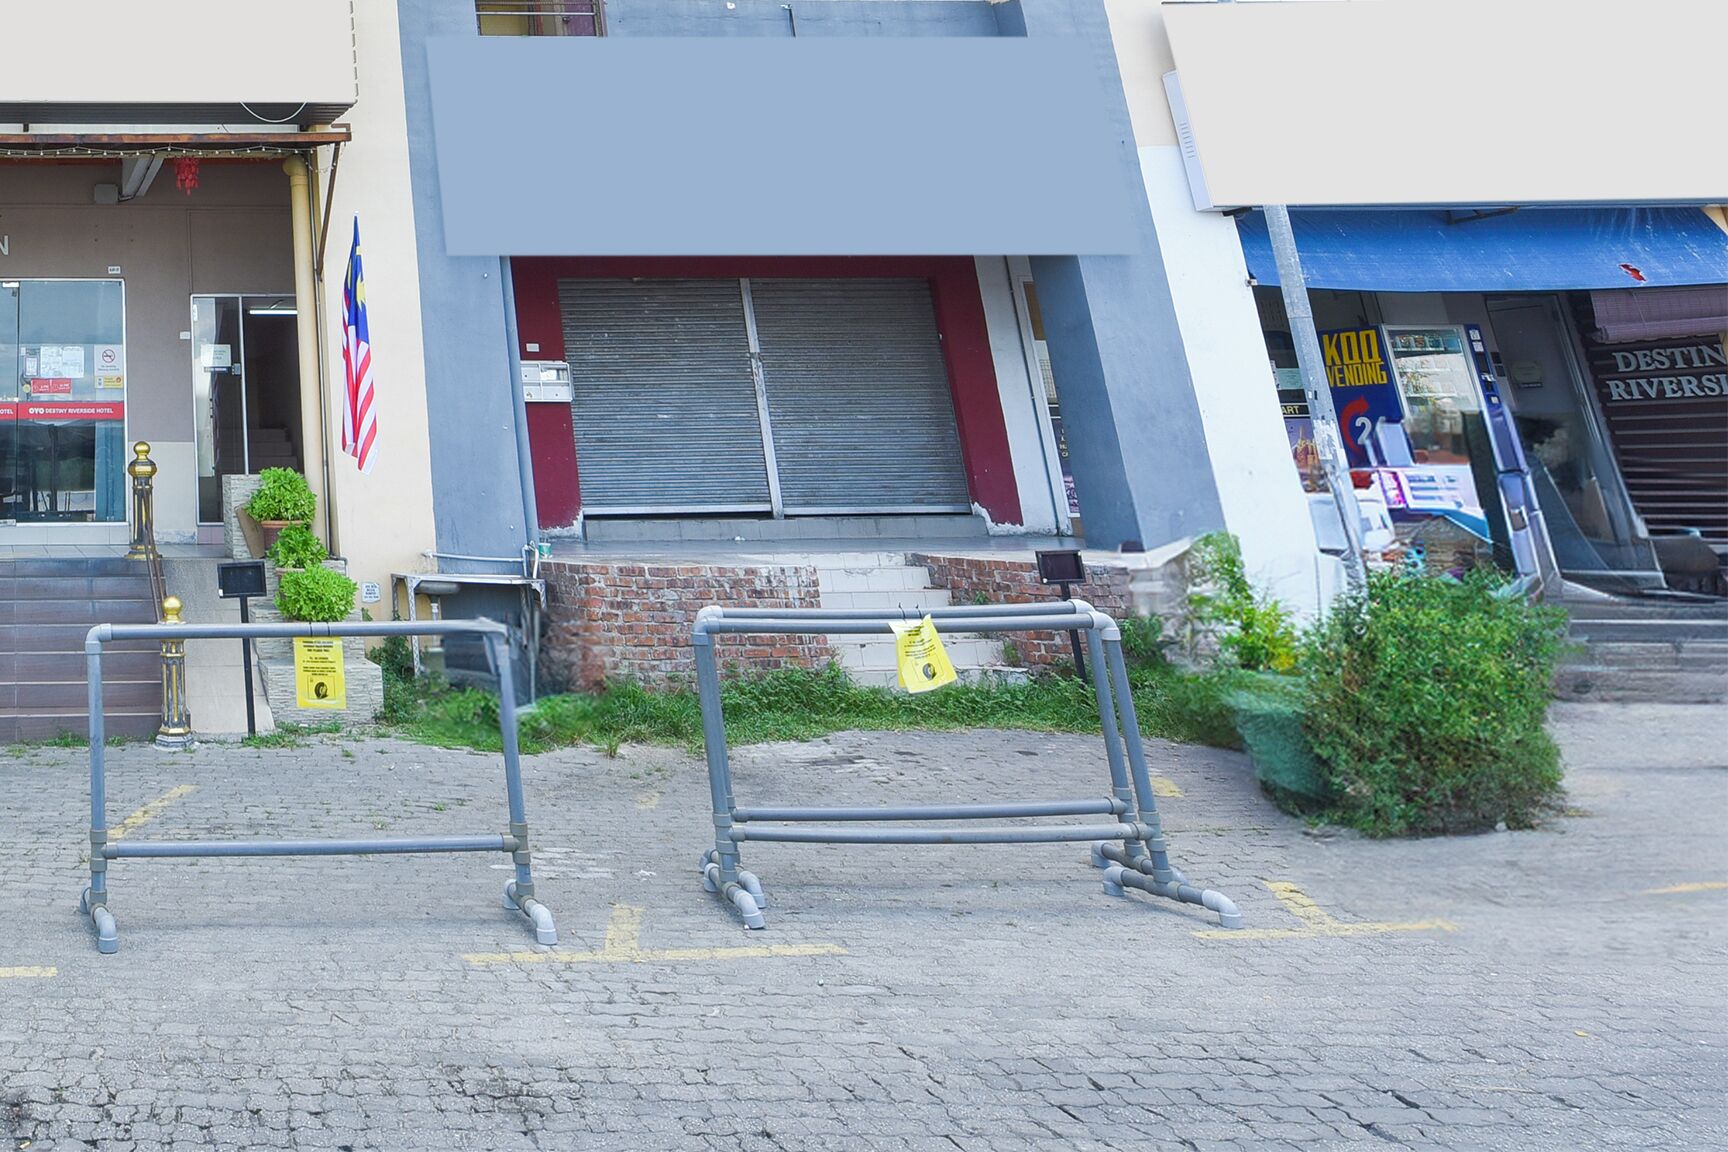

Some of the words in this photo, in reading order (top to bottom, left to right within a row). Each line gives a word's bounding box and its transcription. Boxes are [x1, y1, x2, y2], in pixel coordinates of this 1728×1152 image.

[1612, 344, 1728, 372] DESTIN
[1325, 361, 1388, 388] VENDING
[1606, 373, 1728, 400] RIVERSI
[1281, 405, 1300, 415] ART
